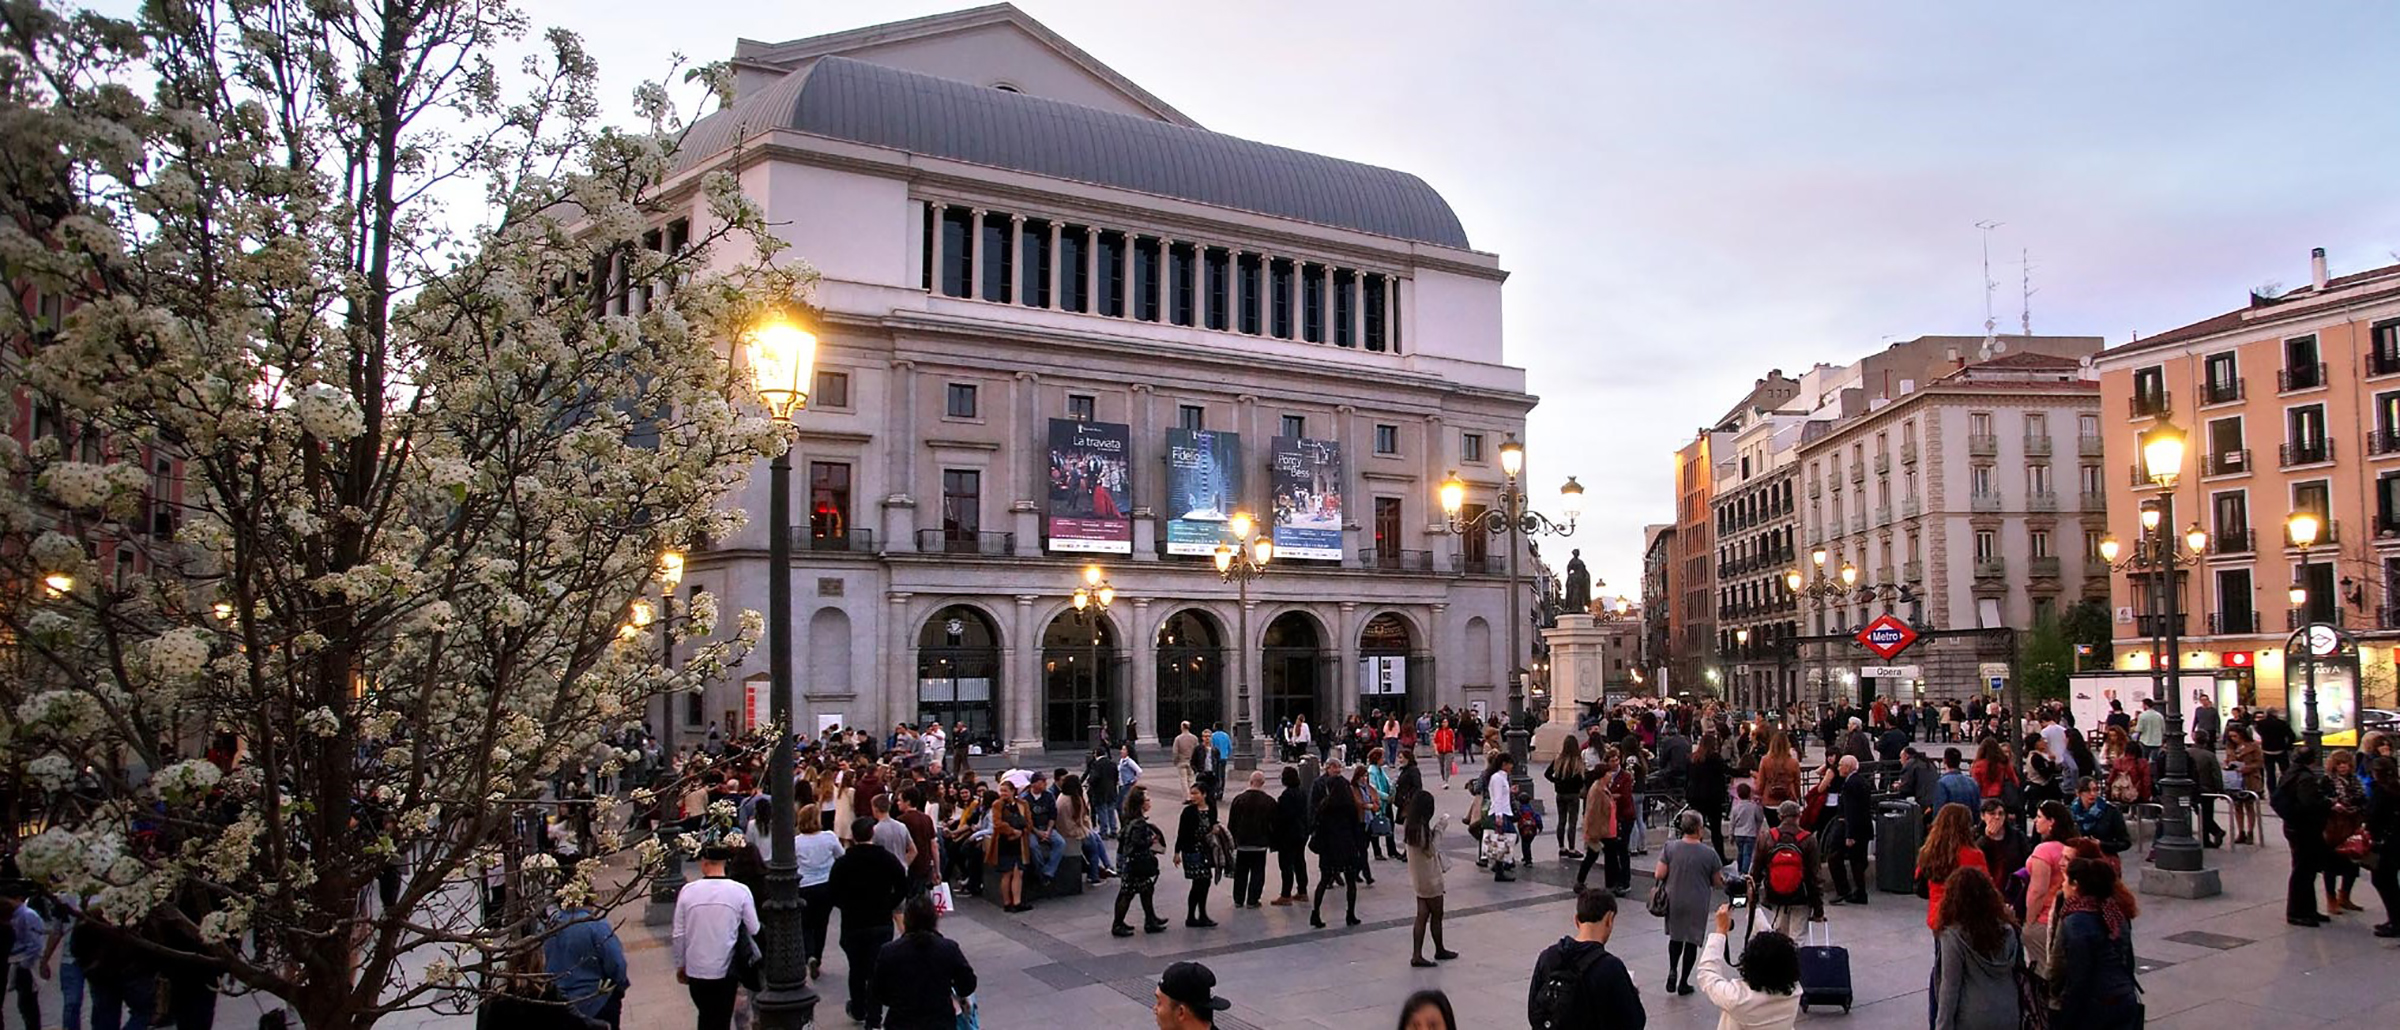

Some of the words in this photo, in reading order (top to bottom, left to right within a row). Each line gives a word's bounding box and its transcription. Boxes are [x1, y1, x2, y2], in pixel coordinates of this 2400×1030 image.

[1073, 436, 1084, 446] La
[1086, 437, 1121, 449] traviata
[1172, 449, 1200, 461] Fidelio
[1278, 454, 1302, 468] Porgy
[1291, 467, 1310, 478] Bess
[1872, 632, 1899, 641] Metro
